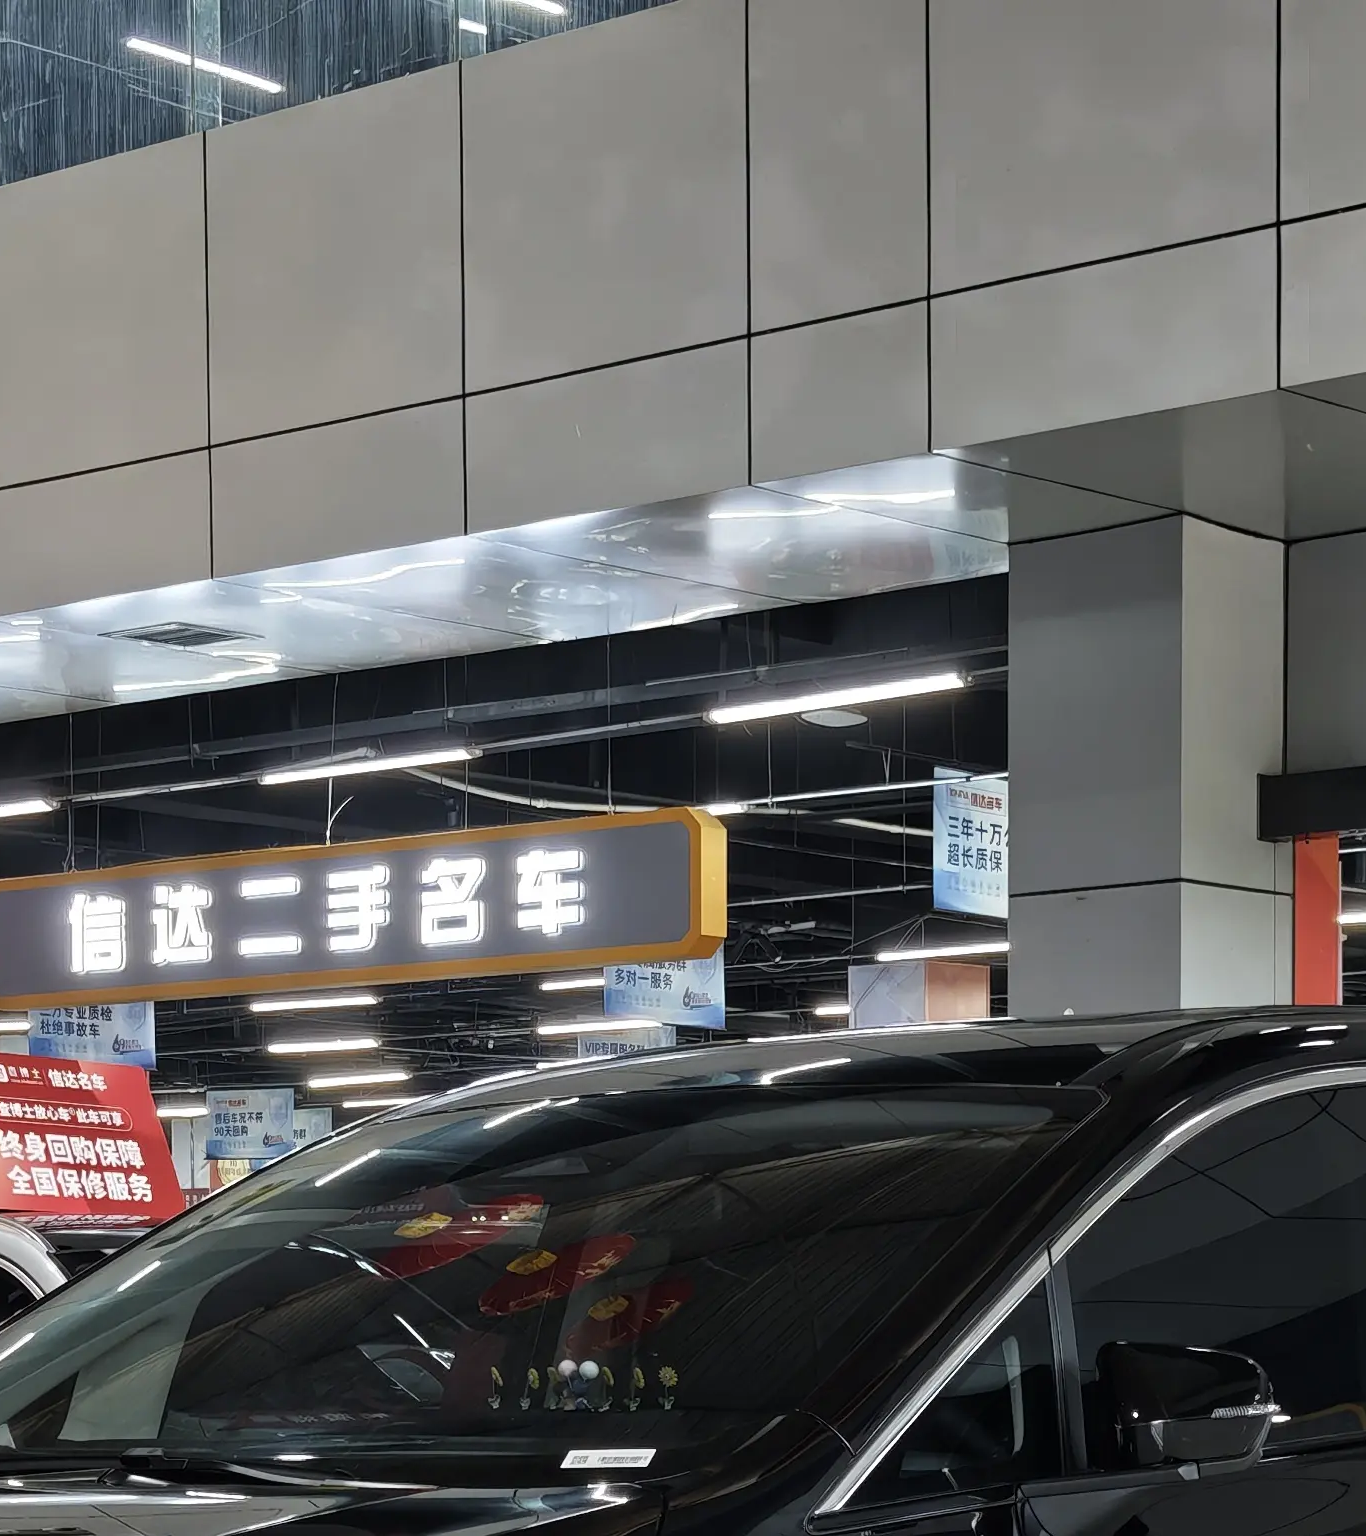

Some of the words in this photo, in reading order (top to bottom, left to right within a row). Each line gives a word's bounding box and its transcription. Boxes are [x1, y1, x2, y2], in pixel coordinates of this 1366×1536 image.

[947, 815, 1009, 847] 三年十万
[947, 843, 1003, 873] 超长质保
[67, 847, 587, 977] 信达二手名车
[614, 967, 673, 991] 多对一服务
[39, 1019, 101, 1039] 杜绝事故车
[47, 1068, 108, 1092] 信达名车
[6, 1164, 153, 1202] 全国保修服务
